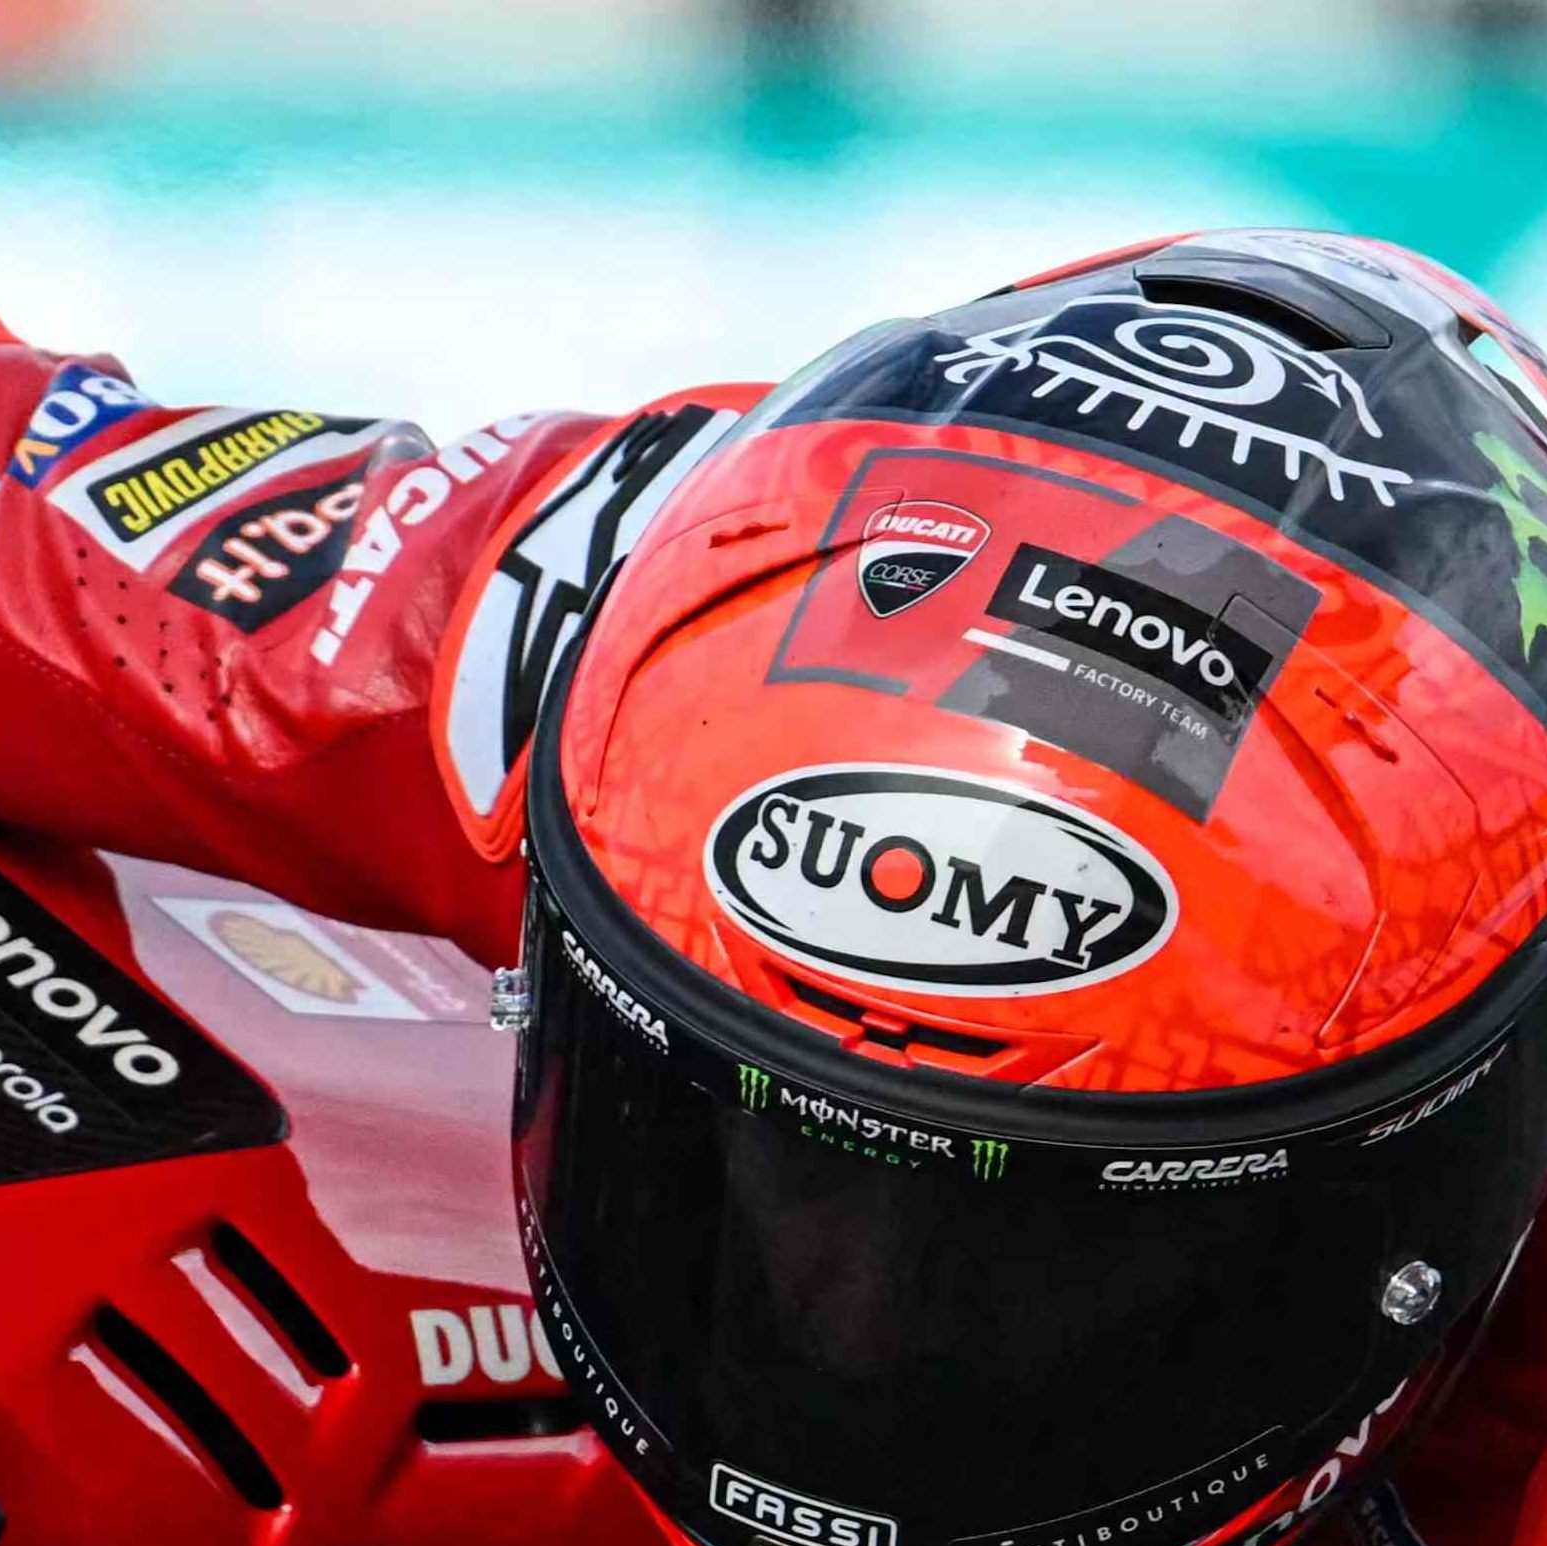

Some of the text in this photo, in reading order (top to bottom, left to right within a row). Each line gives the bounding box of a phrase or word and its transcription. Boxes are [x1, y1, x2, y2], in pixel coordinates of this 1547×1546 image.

[874, 513, 978, 545] DUCATI
[868, 562, 938, 588] CORSE
[1018, 563, 1235, 688] Lenovo
[1071, 663, 1209, 741] FACTORY TEAM
[749, 794, 1123, 971] SUOMY
[563, 930, 670, 1048] CARRERA
[779, 1087, 957, 1158] MONSTER
[800, 1124, 922, 1169] ENERGY
[1101, 1148, 1289, 1183] CARRERA
